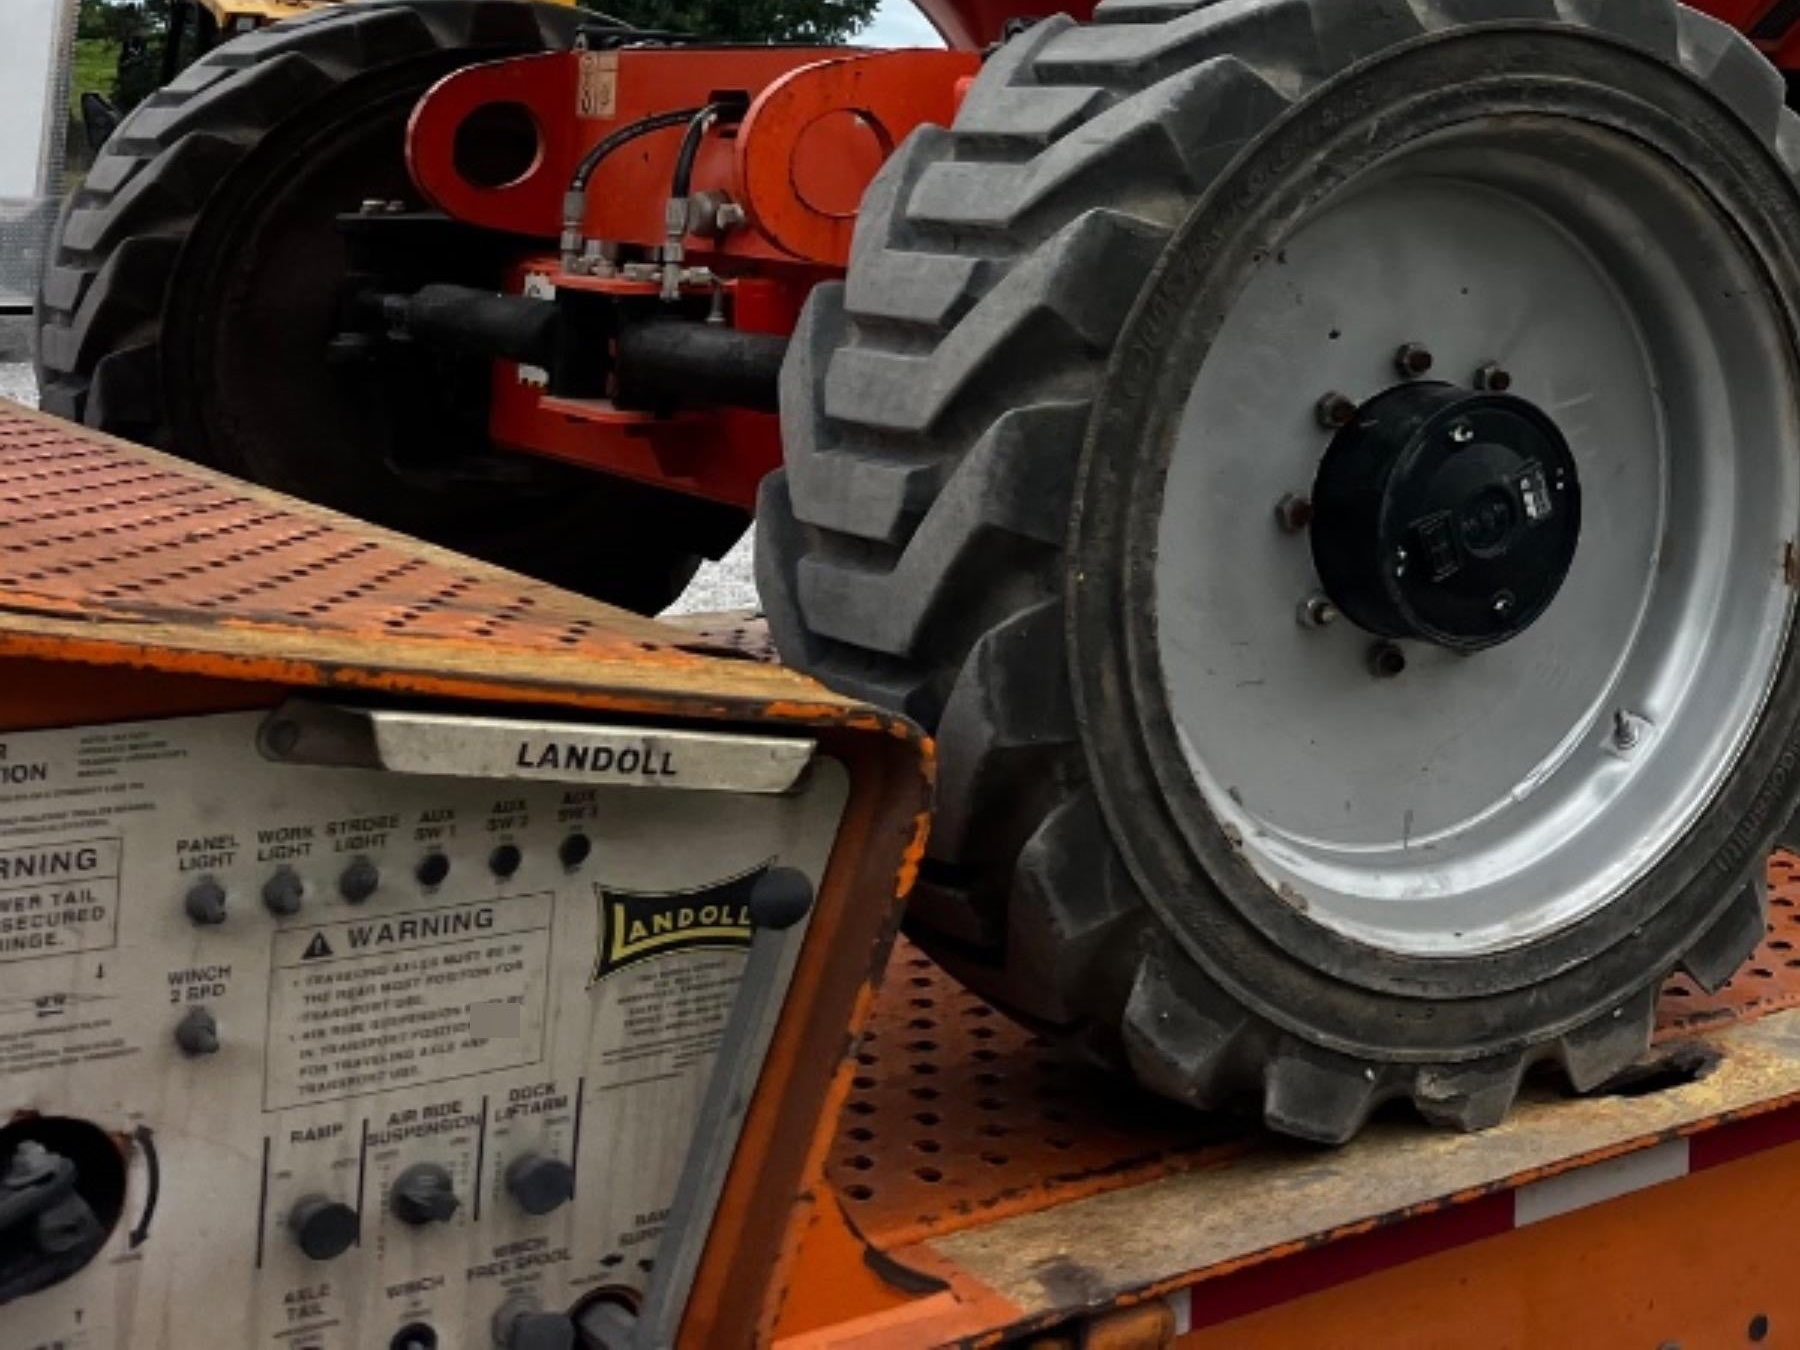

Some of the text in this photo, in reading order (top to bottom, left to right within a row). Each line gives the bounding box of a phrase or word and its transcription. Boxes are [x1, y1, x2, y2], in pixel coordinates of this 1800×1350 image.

[515, 741, 678, 776] LANDOLL
[256, 825, 316, 845] WORK
[325, 815, 400, 838] STROBE
[176, 834, 241, 855] PANEL
[256, 842, 314, 863] LIGHT
[335, 833, 391, 853] LIGHT
[0, 848, 98, 880] RNING
[178, 850, 237, 872] LIGHT
[49, 888, 98, 907] TAIL
[1, 905, 106, 933] SECURED
[347, 907, 495, 950] WARNING
[610, 902, 754, 963] LANDOLL
[167, 964, 233, 988] WINCH
[169, 982, 228, 1004] 2 SPD
[508, 1082, 557, 1103] DOCK
[386, 1100, 464, 1128] AIR RIDE
[289, 1123, 344, 1145] RAMP
[365, 1112, 483, 1148] SUSPENSION
